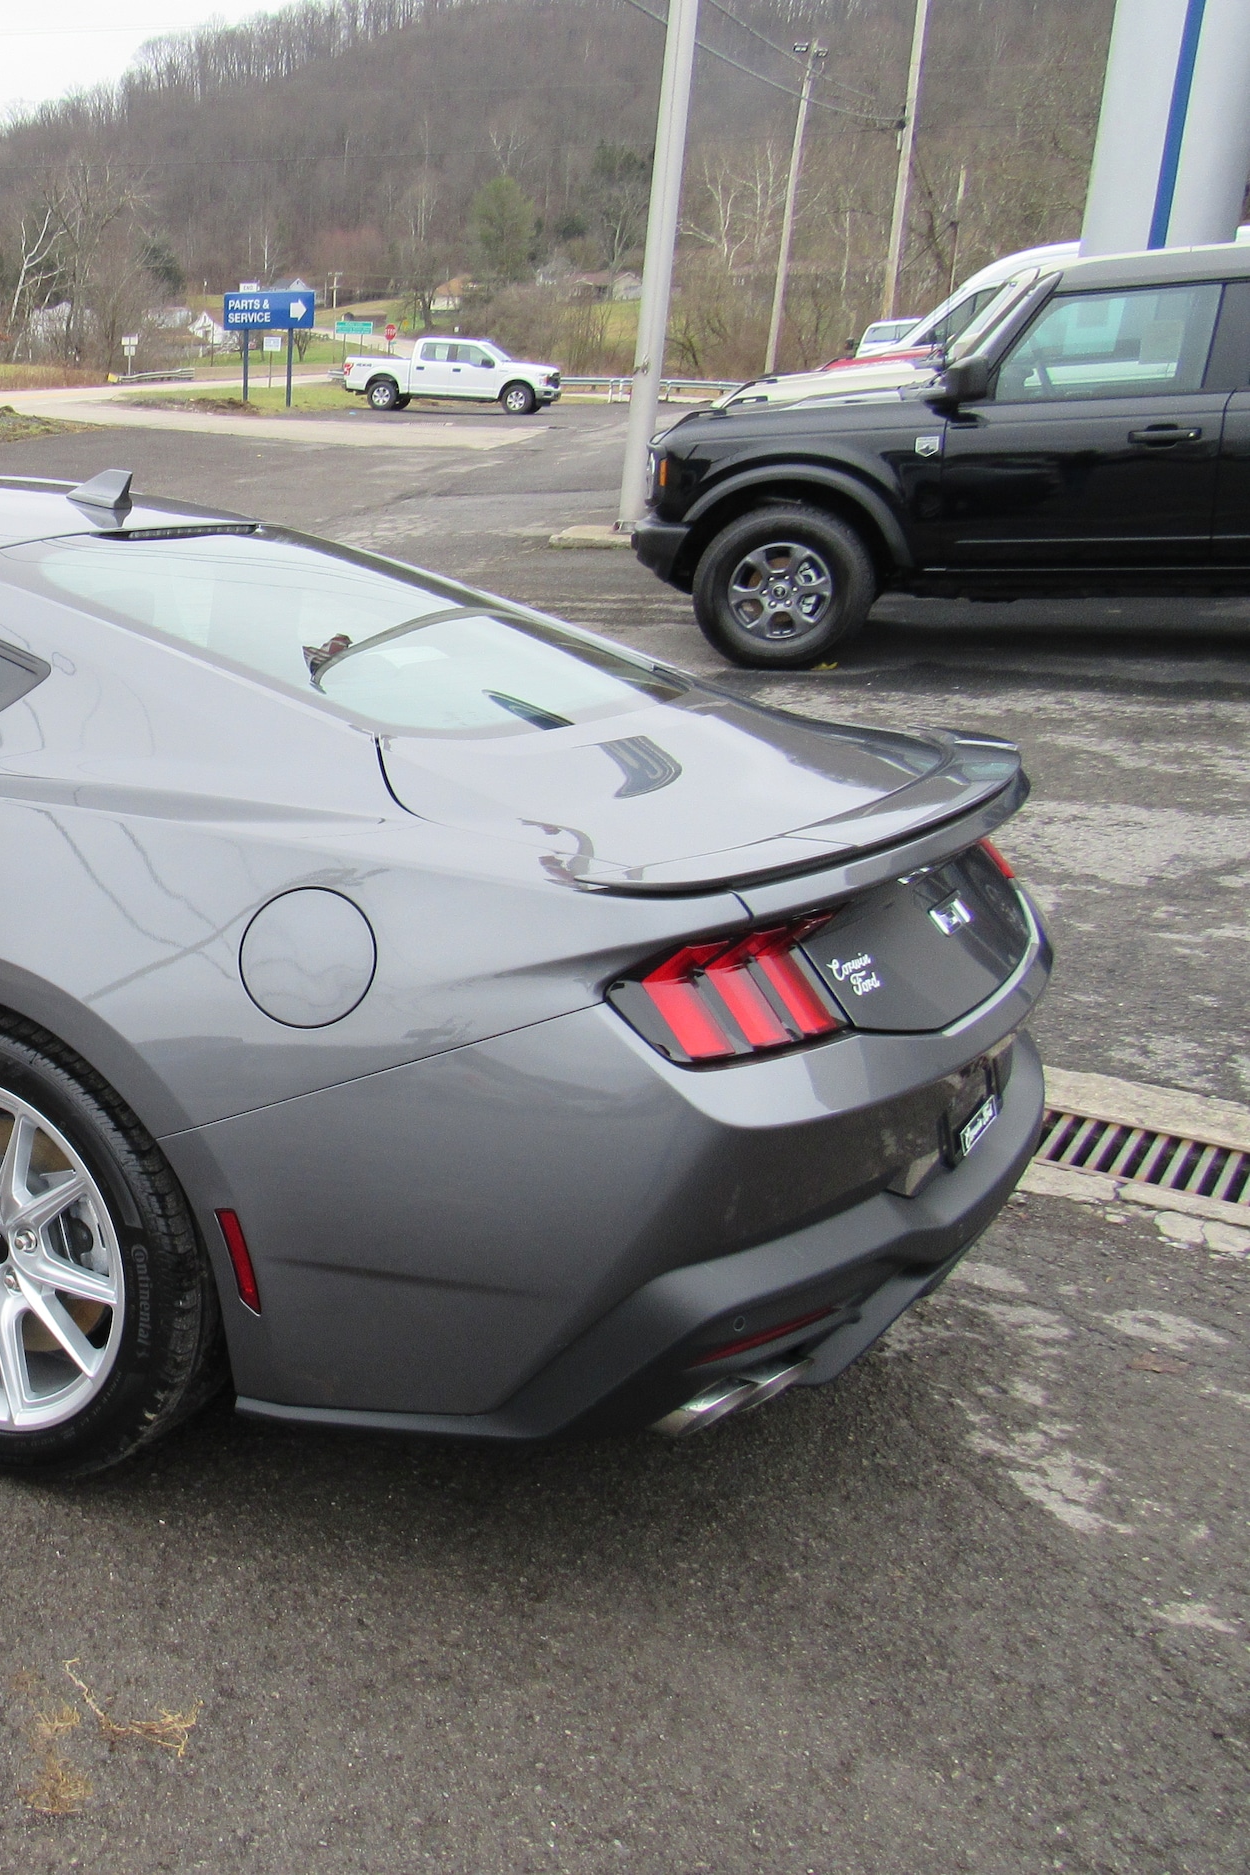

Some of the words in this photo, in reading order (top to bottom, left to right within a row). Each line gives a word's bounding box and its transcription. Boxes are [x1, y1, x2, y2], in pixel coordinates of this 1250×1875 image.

[228, 299, 260, 310] PARTS
[262, 298, 270, 310] &
[228, 312, 271, 323] SERVICE
[384, 328, 397, 336] STOP
[826, 952, 872, 981] Corwin
[849, 970, 881, 996] Ford
[131, 1243, 153, 1346] Continental
